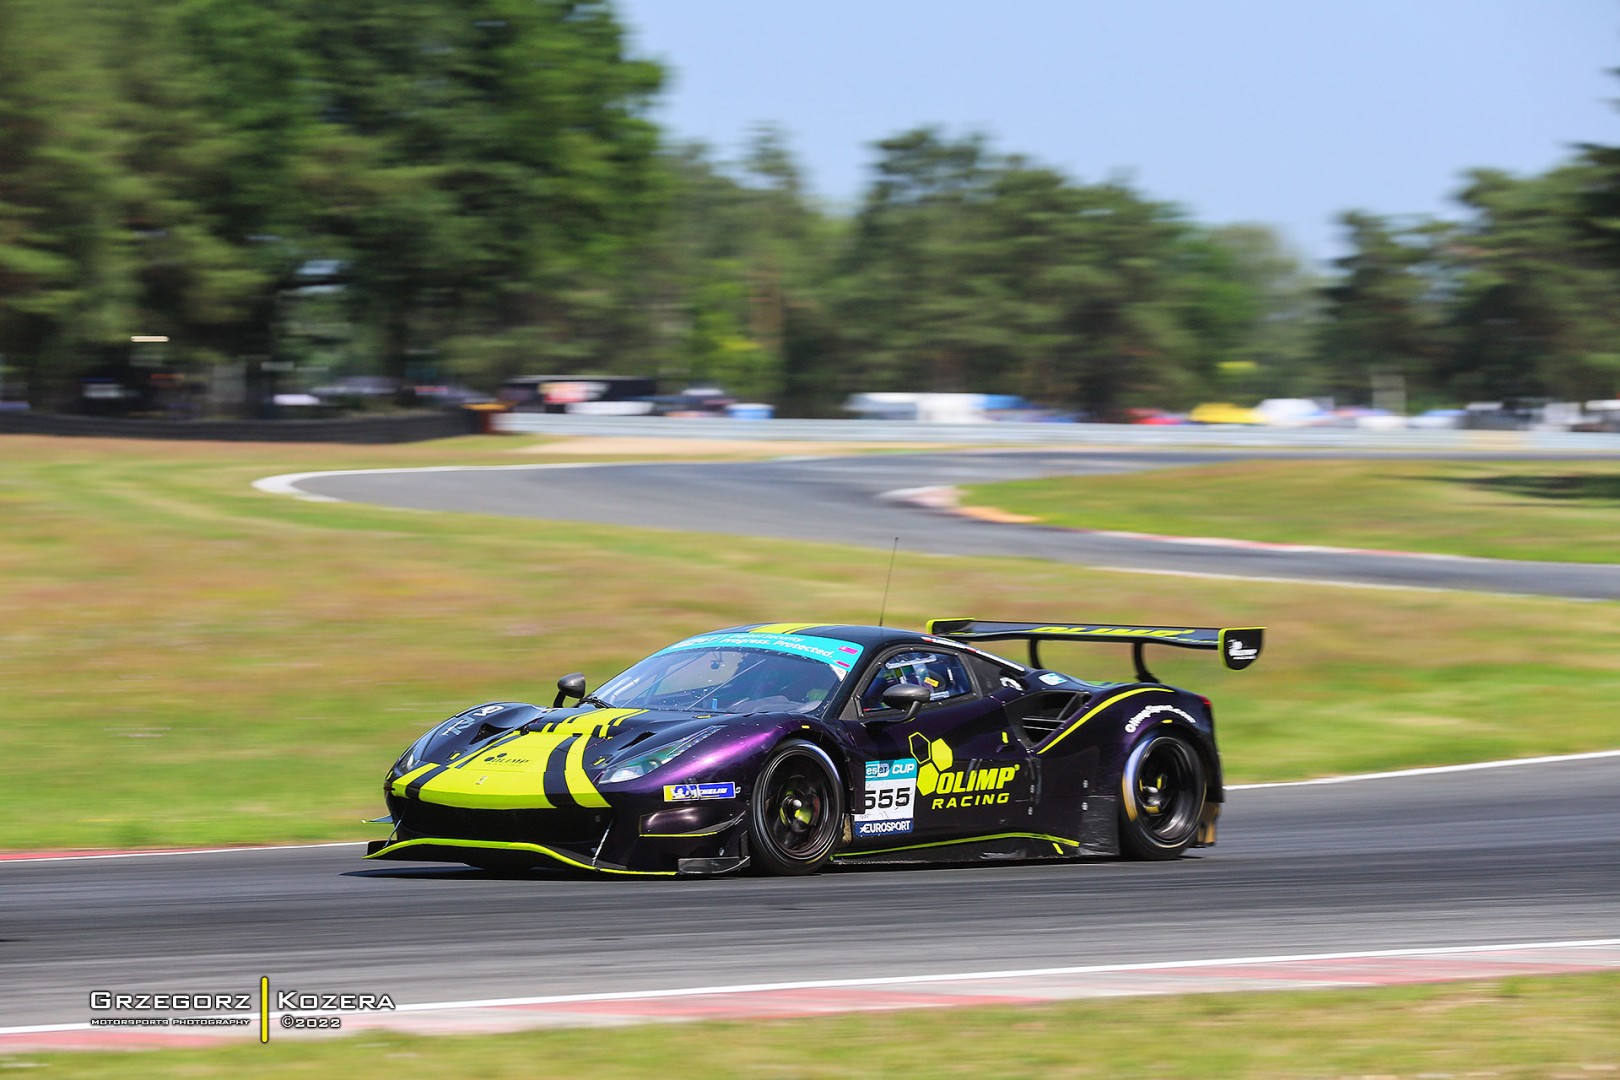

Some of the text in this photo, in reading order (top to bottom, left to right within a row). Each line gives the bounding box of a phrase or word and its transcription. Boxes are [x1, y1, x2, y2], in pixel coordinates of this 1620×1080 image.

[772, 640, 834, 658] Protected.
[892, 763, 915, 775] CUP
[931, 792, 1010, 810] RACING
[864, 820, 911, 834] EUROSPORT
